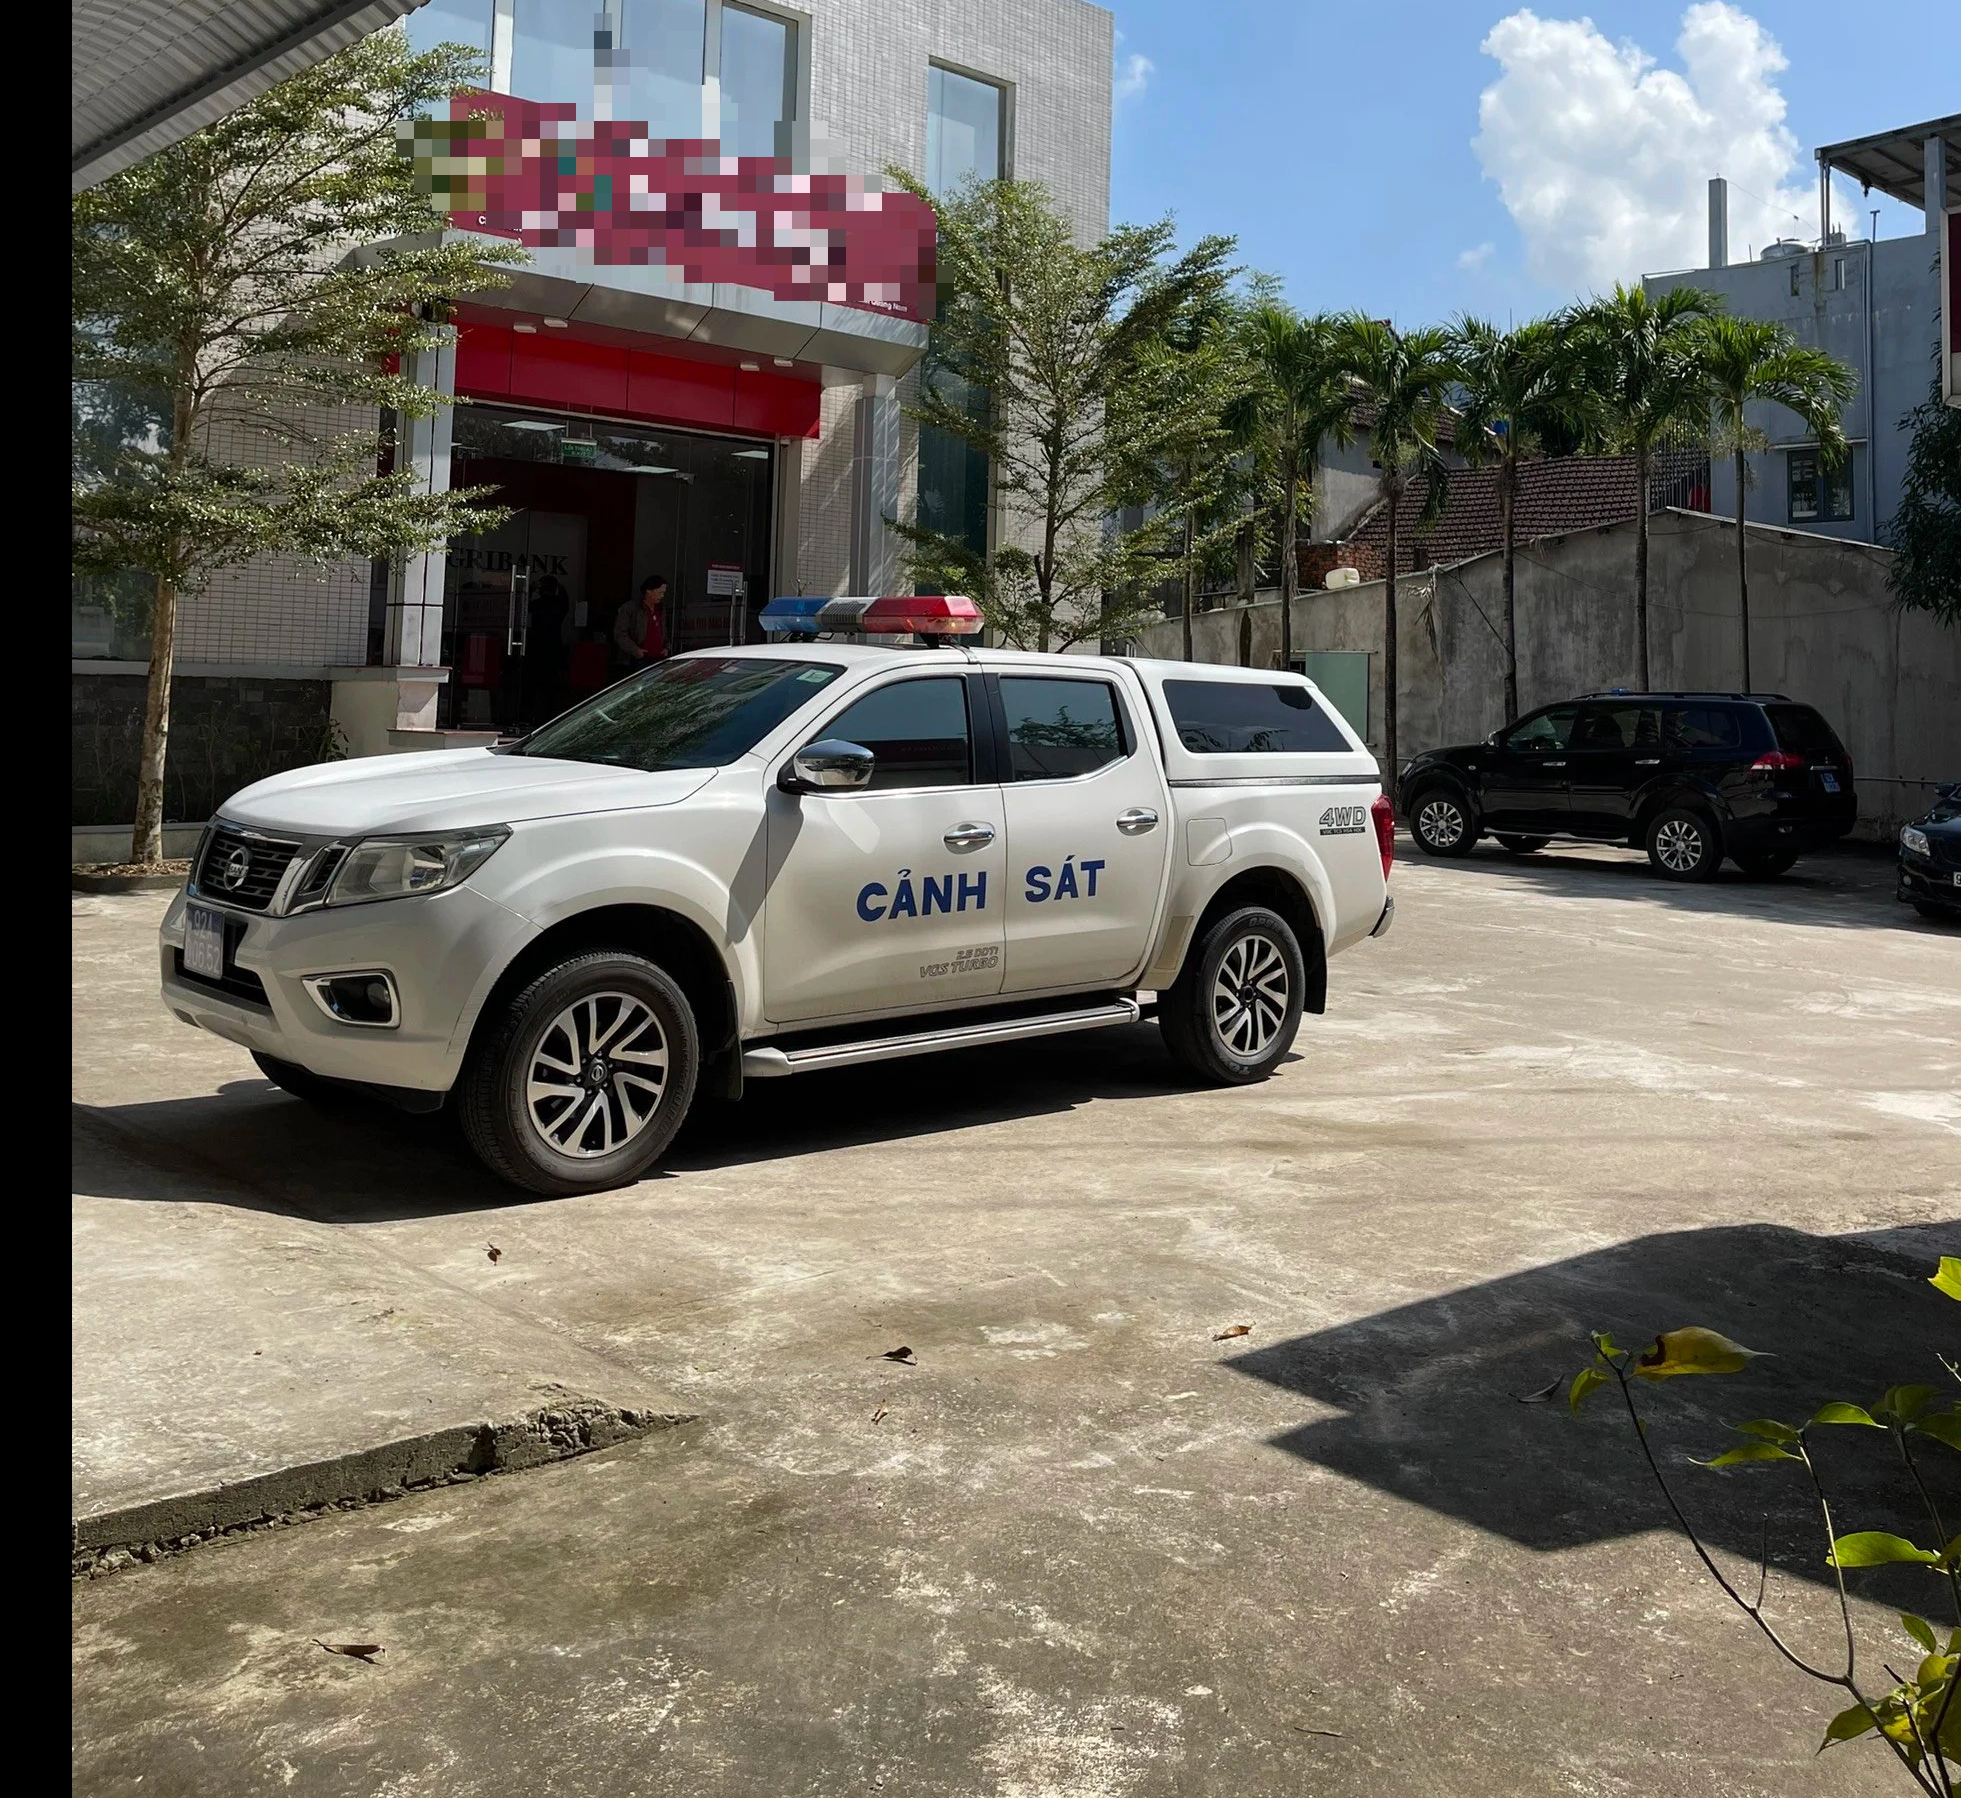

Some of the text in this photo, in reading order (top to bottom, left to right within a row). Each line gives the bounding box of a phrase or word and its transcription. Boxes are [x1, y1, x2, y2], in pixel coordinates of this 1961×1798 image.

[1319, 806, 1367, 827] 4WD
[856, 854, 1105, 922] CẢNH SÁT
[950, 955, 999, 973] TURBO
